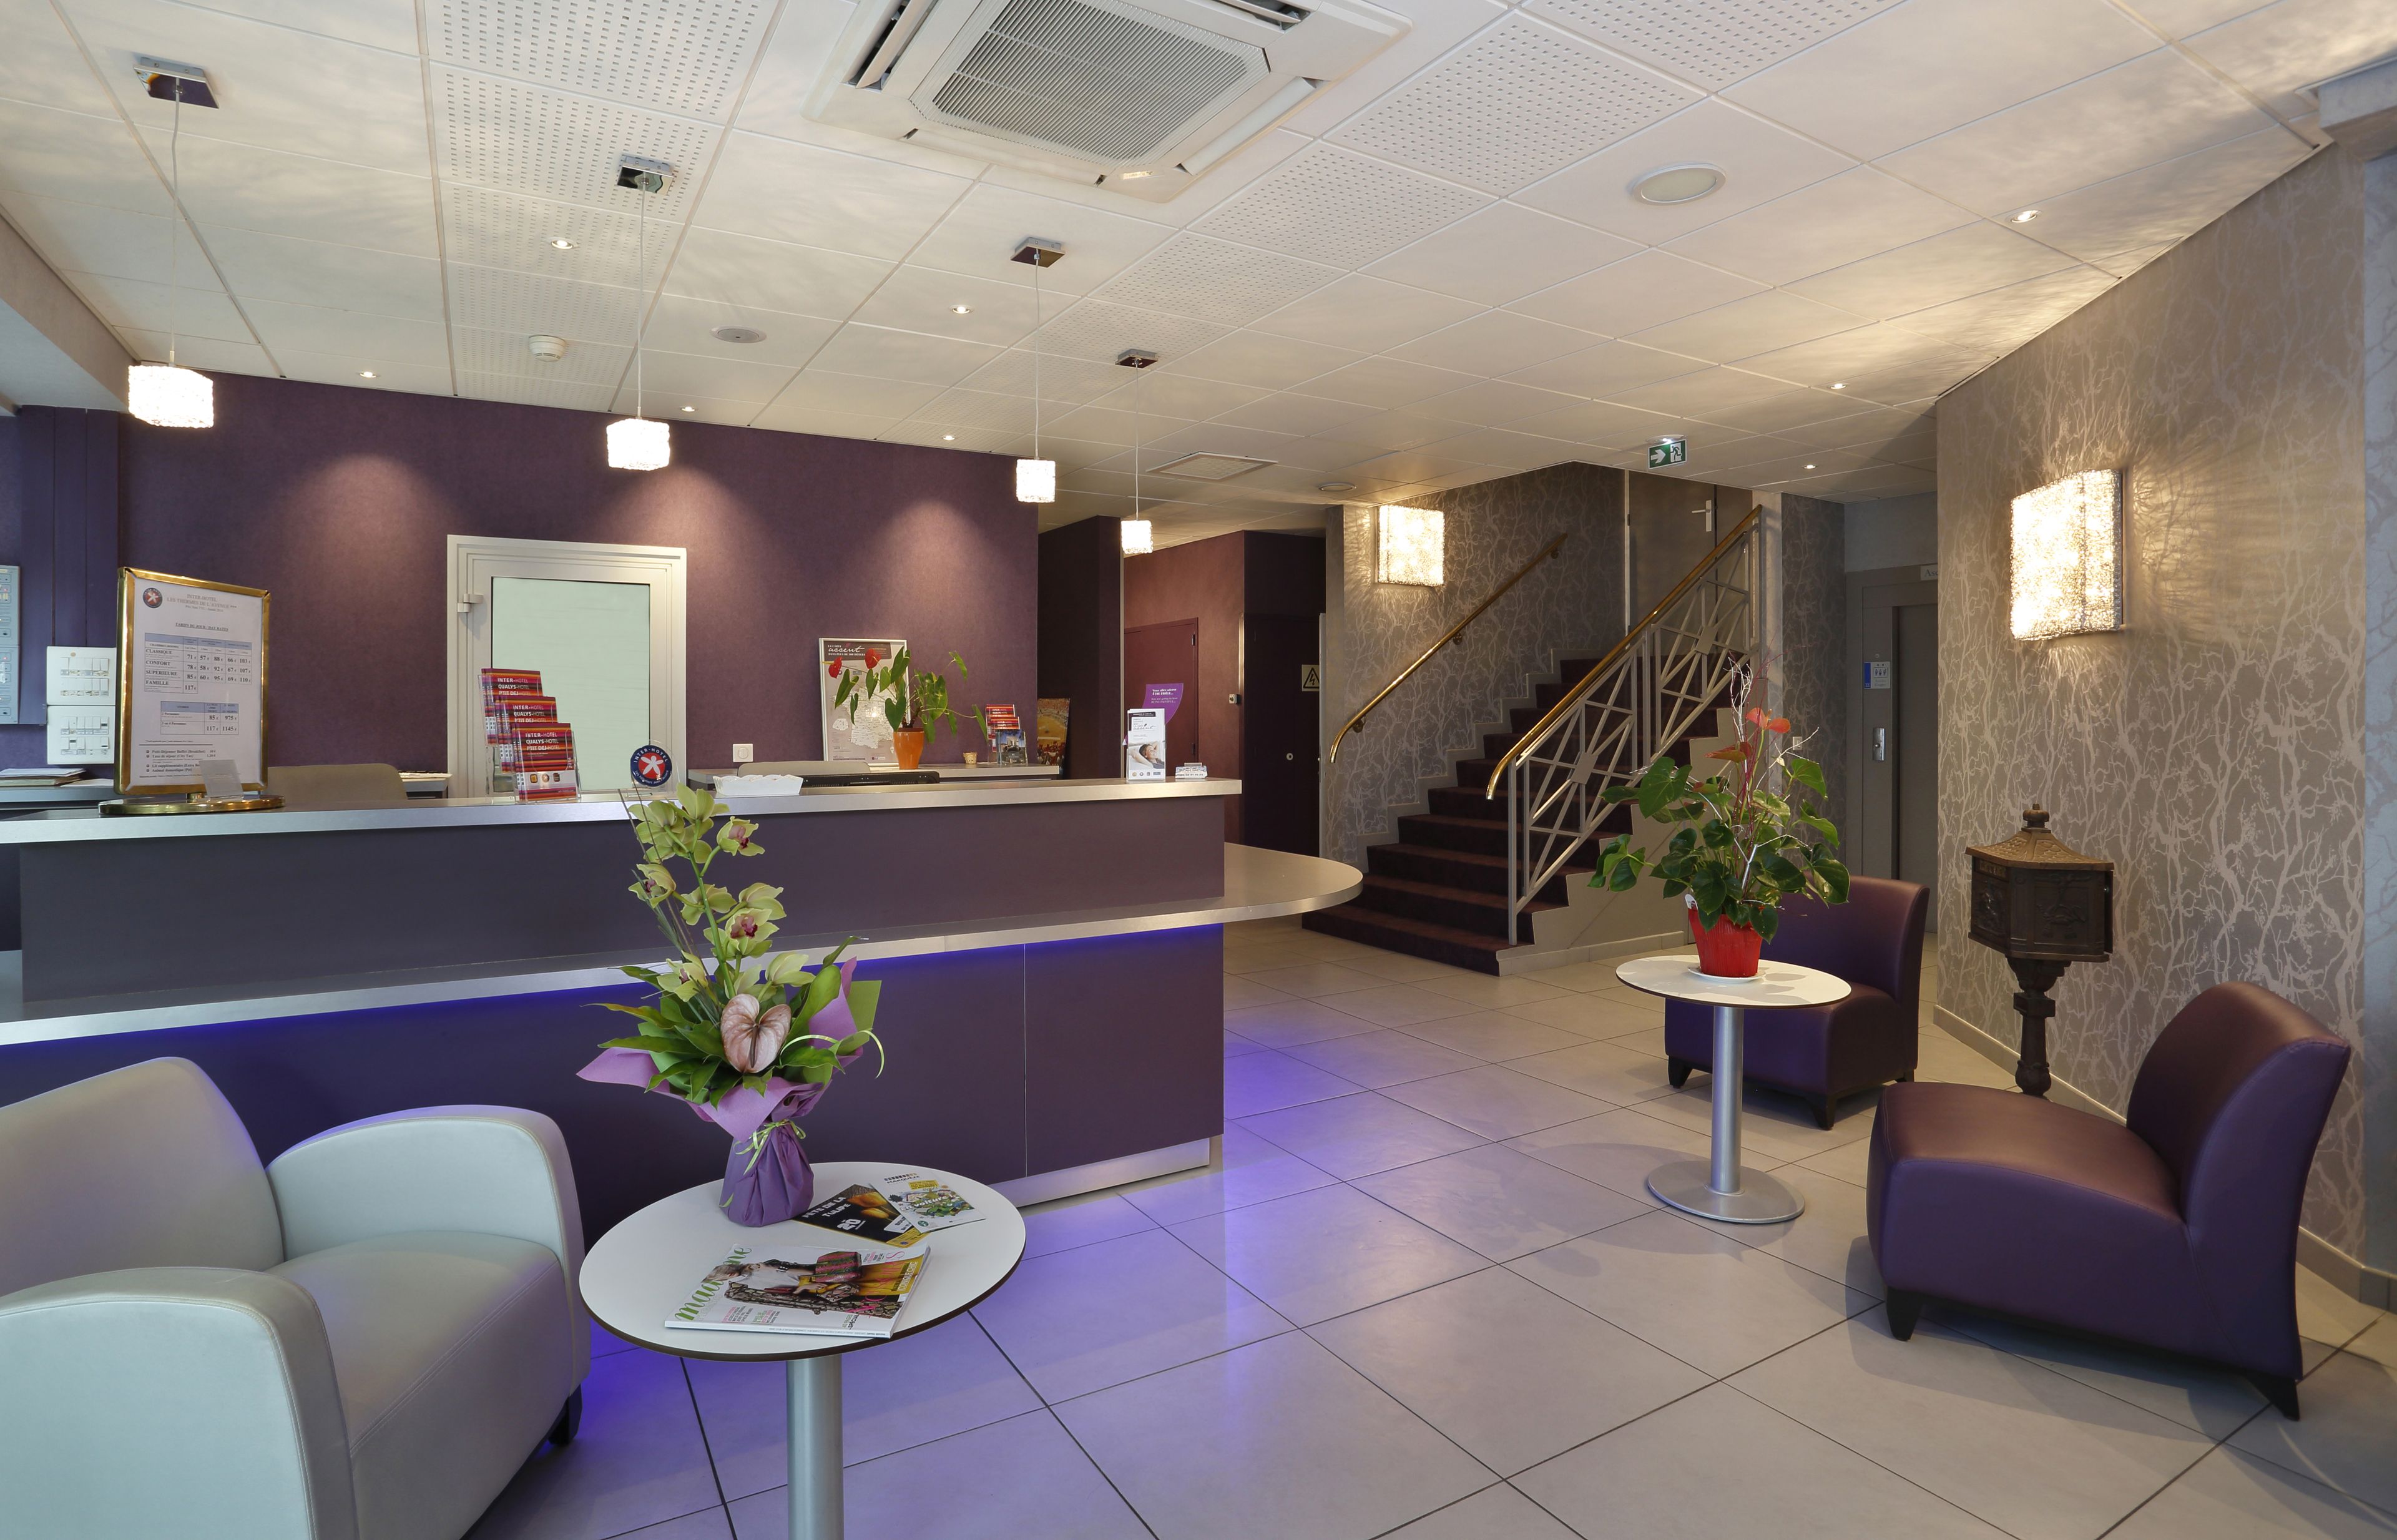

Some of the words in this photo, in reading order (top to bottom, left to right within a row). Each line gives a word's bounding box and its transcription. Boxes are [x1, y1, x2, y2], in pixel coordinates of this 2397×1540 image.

[913, 1196, 948, 1207] voiture
[821, 1204, 851, 1217] TULIPE
[675, 1248, 752, 1320] madme
